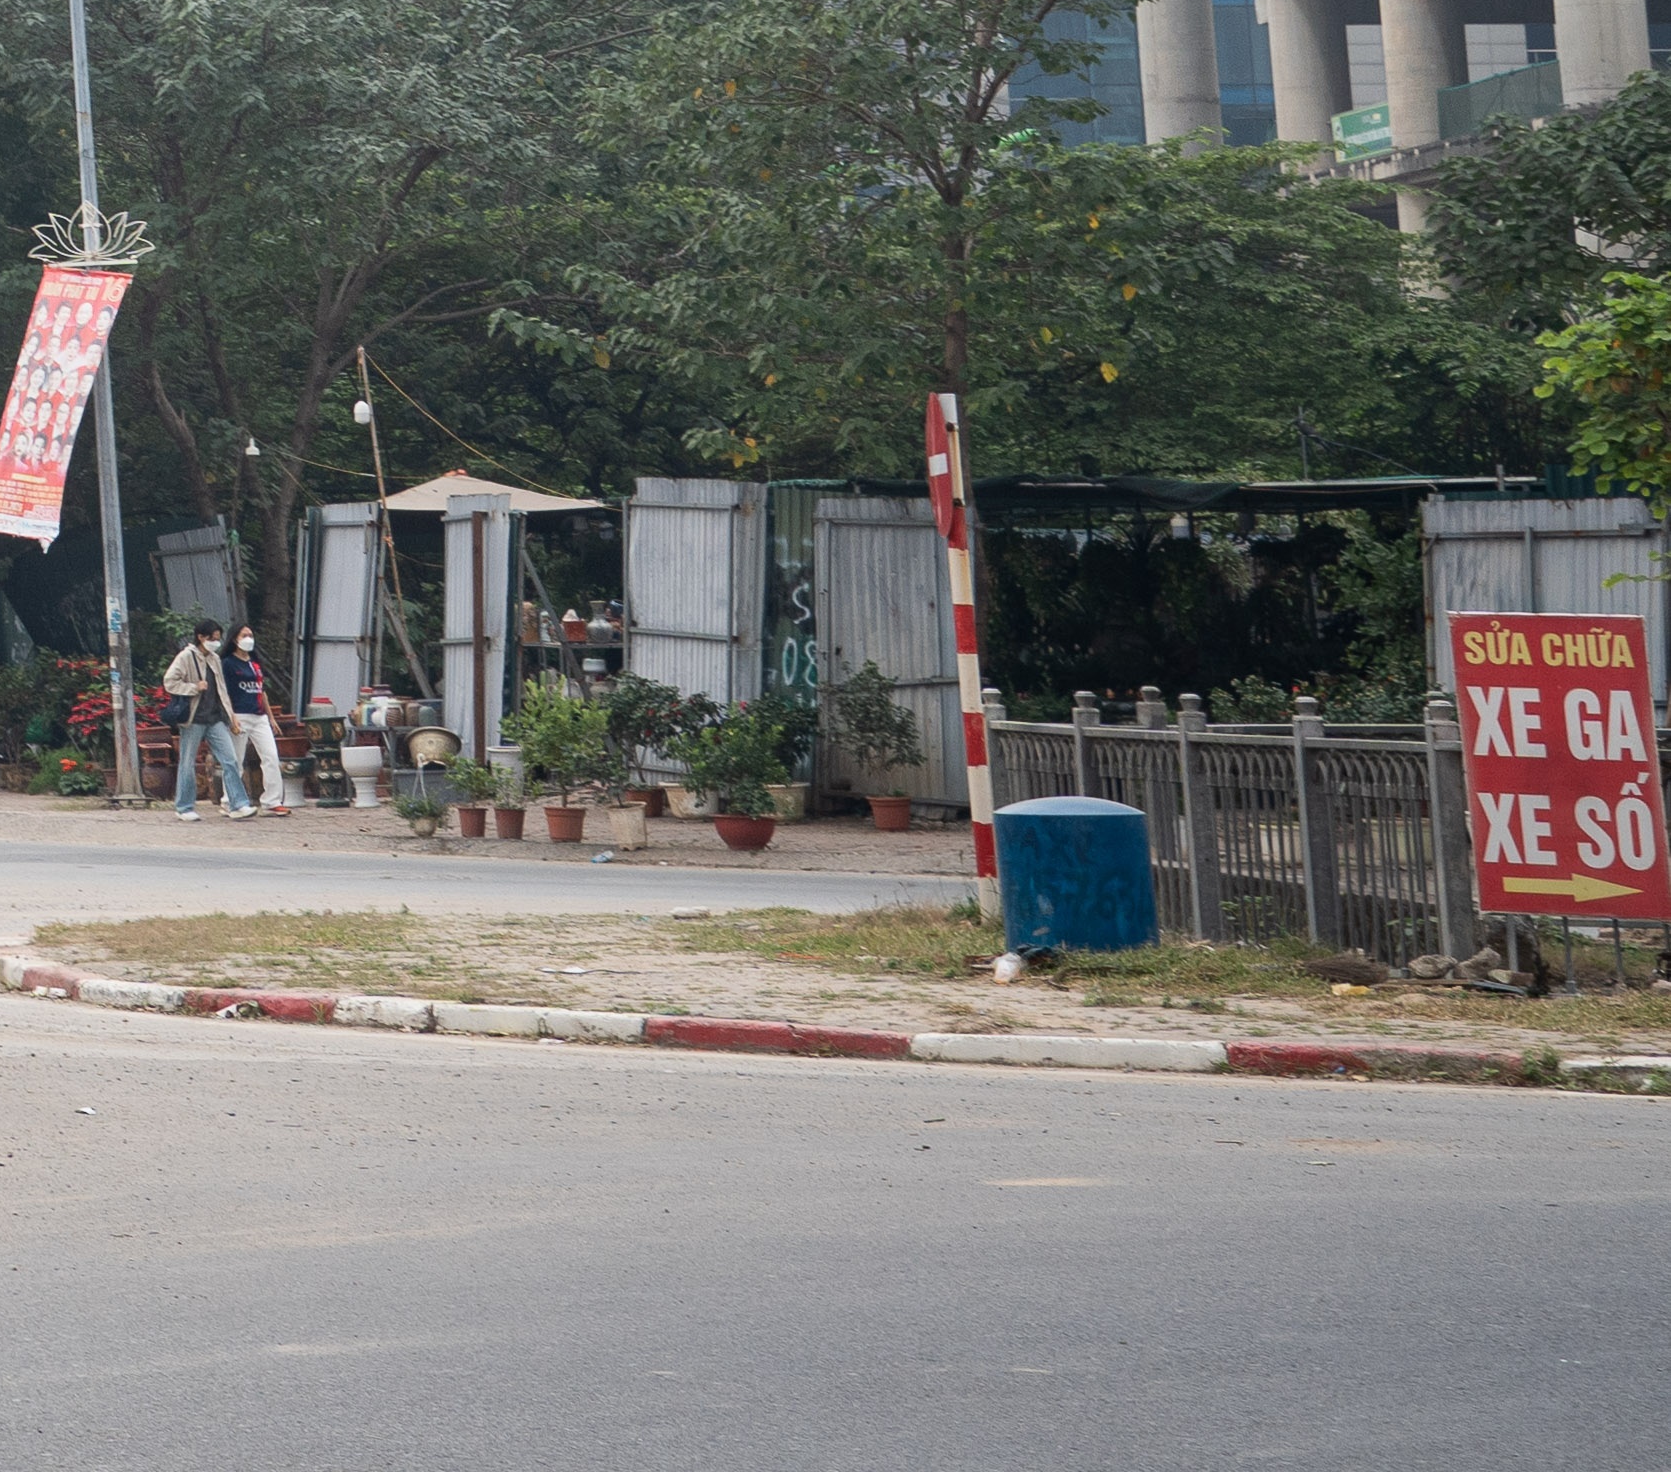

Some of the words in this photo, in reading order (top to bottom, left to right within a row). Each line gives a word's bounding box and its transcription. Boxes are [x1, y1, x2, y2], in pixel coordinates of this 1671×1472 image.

[1463, 620, 1533, 666] SỬA
[1541, 627, 1635, 668] CHỮA
[1466, 686, 1547, 758] XE
[1563, 688, 1649, 761] GA
[1477, 792, 1558, 866] XE
[1574, 772, 1656, 871] SỐ
